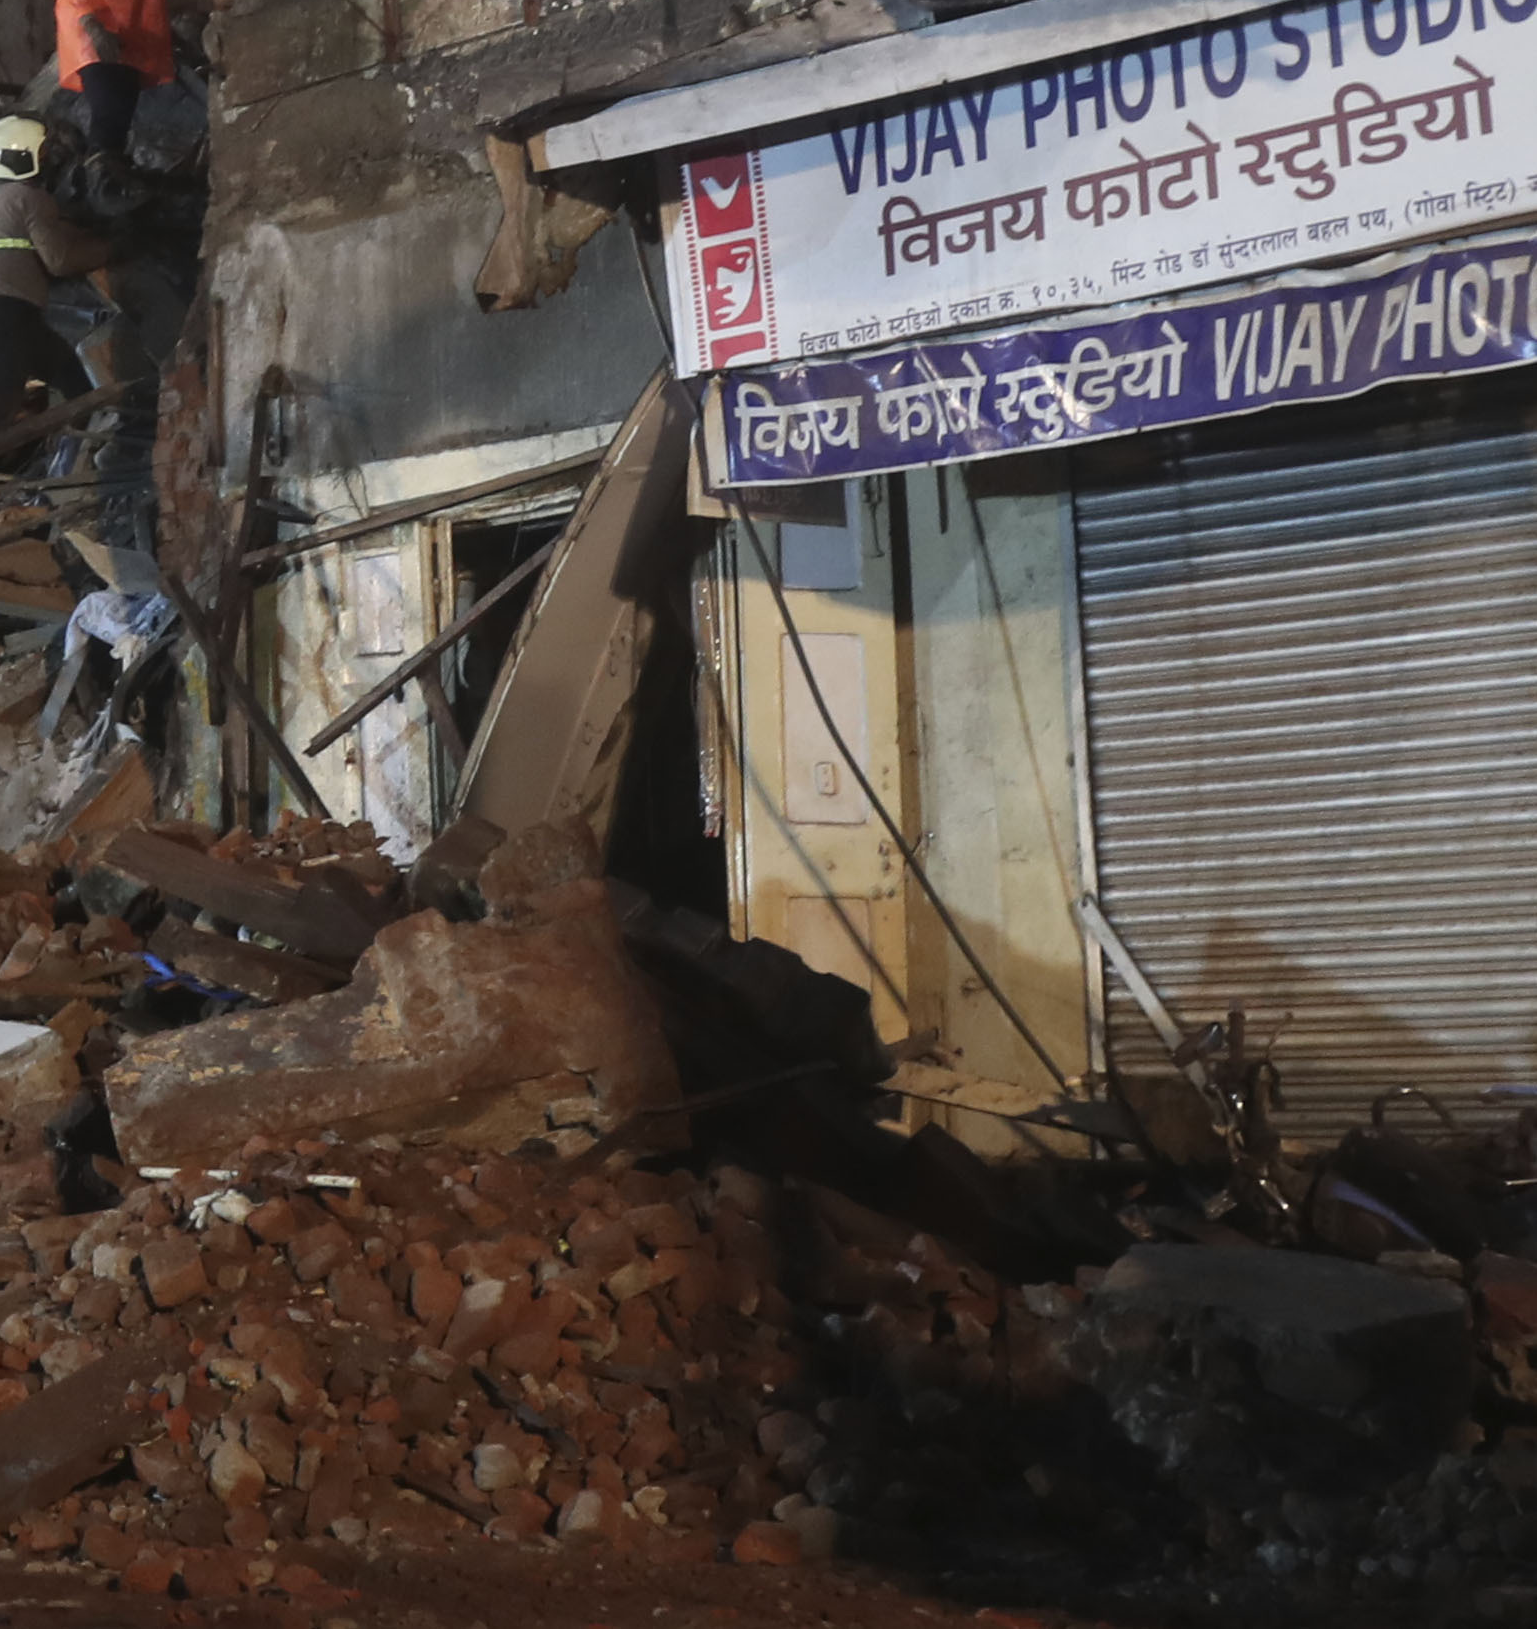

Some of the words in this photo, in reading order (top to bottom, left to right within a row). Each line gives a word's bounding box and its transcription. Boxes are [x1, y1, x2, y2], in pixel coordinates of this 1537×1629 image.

[831, 87, 995, 196] VIJAY
[1022, 23, 1249, 150] PHOTO
[878, 186, 1048, 278] विजय
[1063, 120, 1222, 228] फोटो
[1234, 54, 1496, 201] स्टुडियो
[798, 331, 840, 356] विजय
[845, 315, 881, 345] फोटो
[1153, 249, 1183, 276] रोड
[1189, 240, 1211, 269] डॉ
[1214, 294, 1369, 402] VIJAY
[1370, 255, 1537, 372] PHOT
[733, 381, 863, 460] विजय
[992, 319, 1189, 442] स्टुडियो
